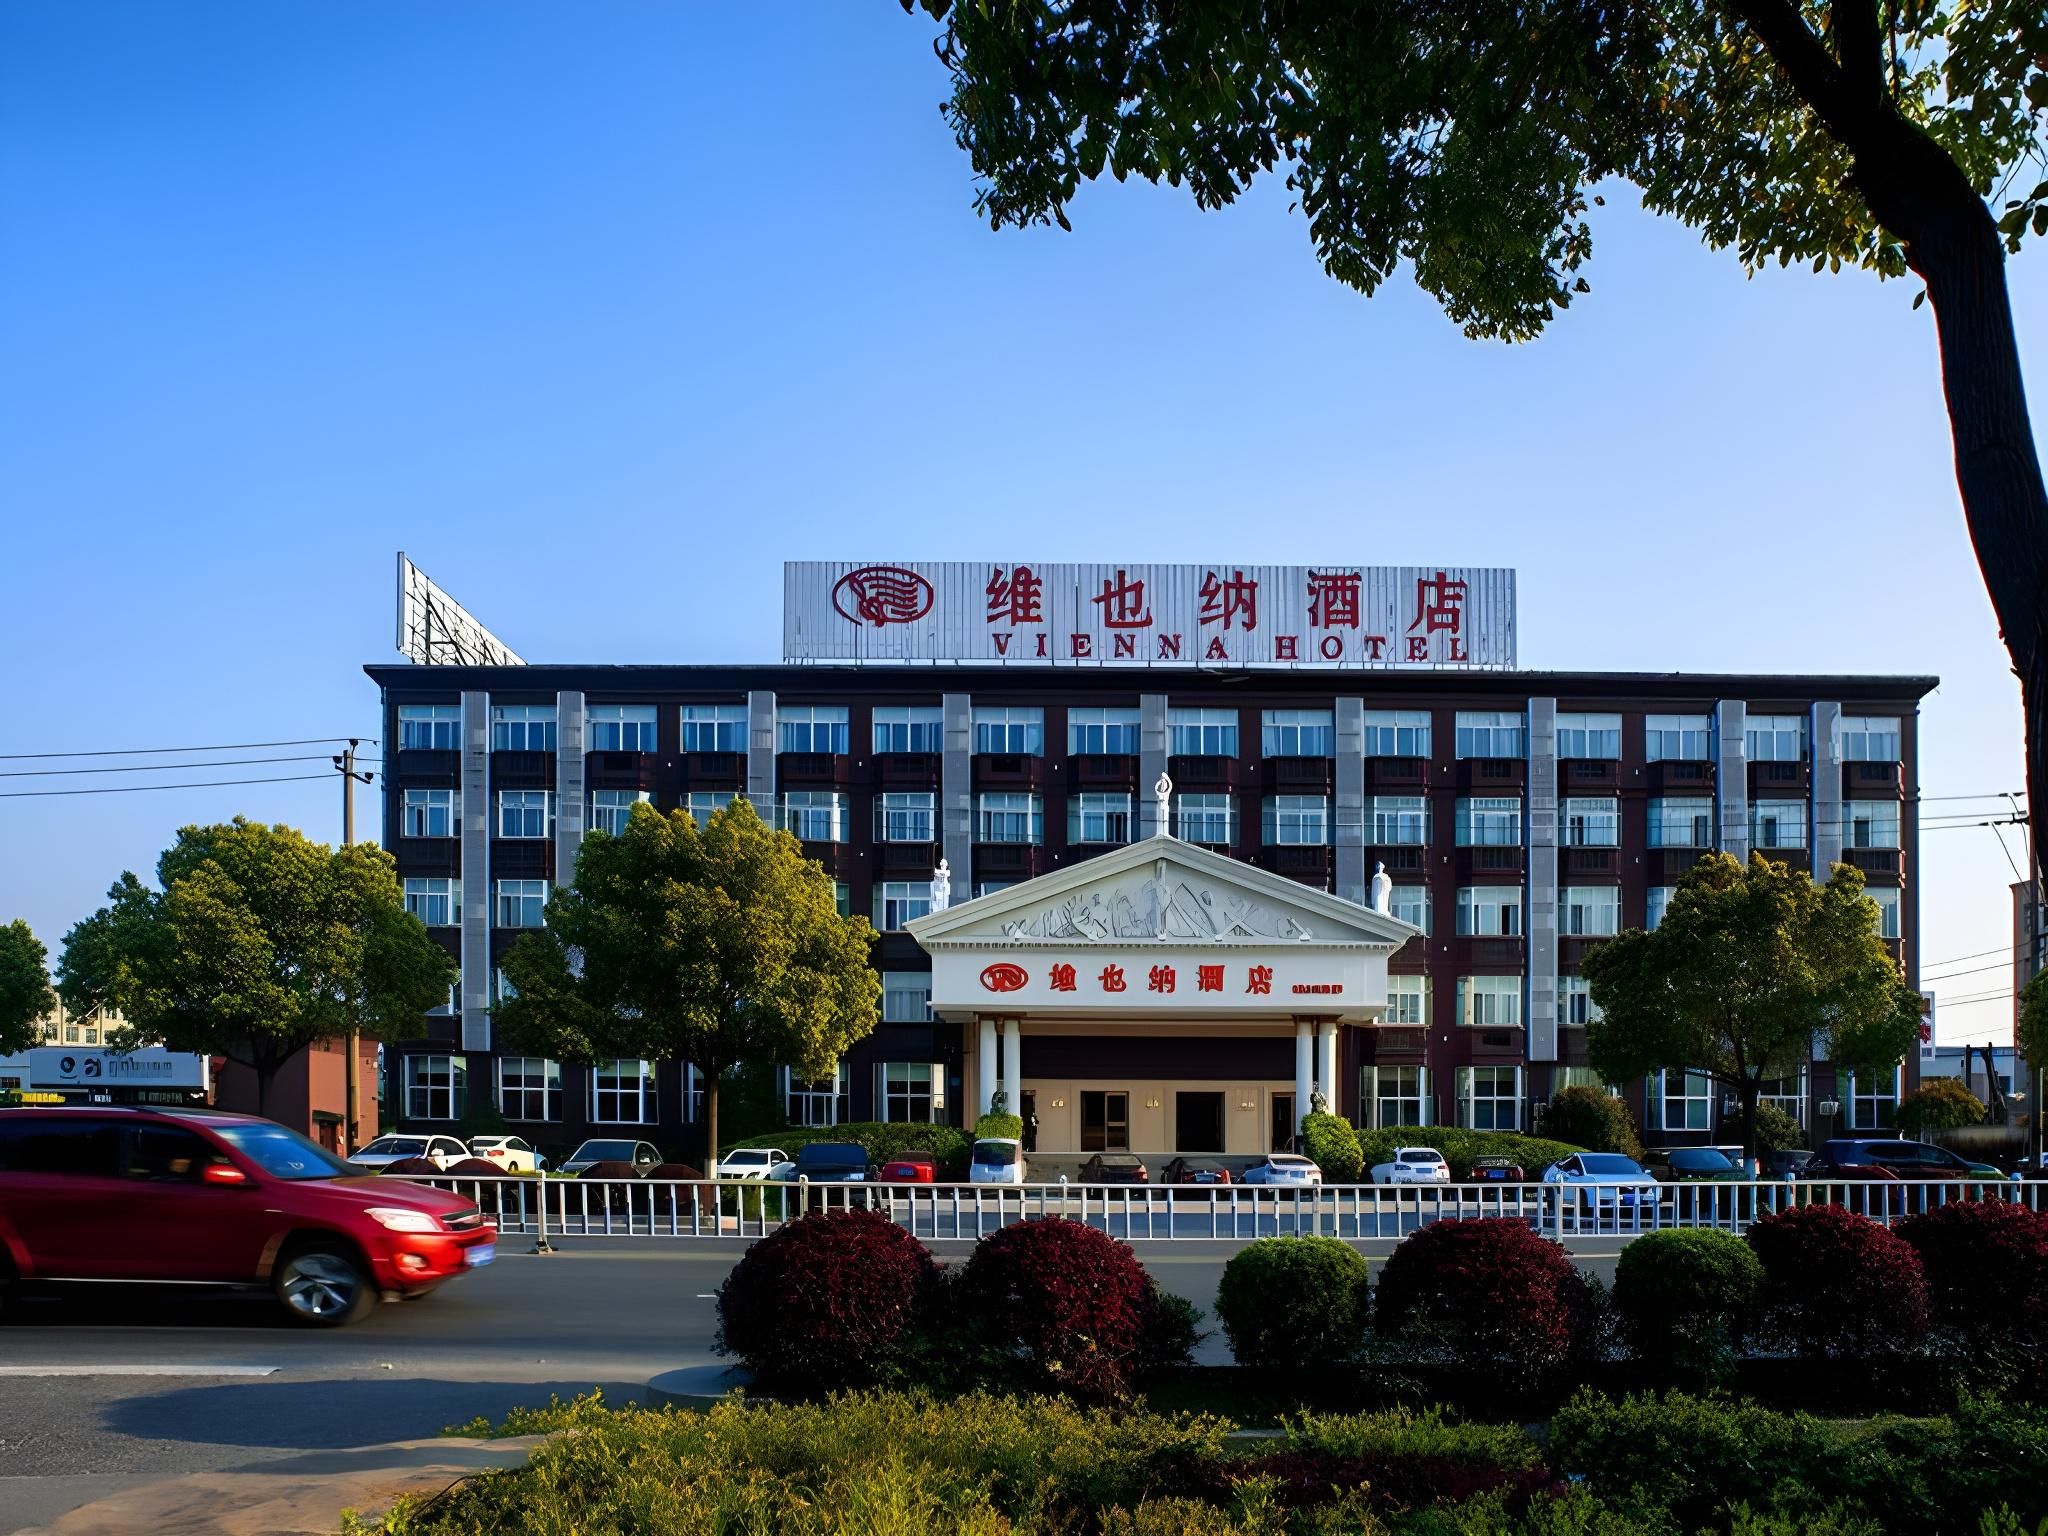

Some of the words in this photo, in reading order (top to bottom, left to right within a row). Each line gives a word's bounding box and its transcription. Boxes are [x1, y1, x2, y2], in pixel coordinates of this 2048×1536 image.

[986, 565, 1468, 635] 维也纳酒店
[993, 633, 1229, 660] VIENNA
[1275, 635, 1469, 662] HOTEL
